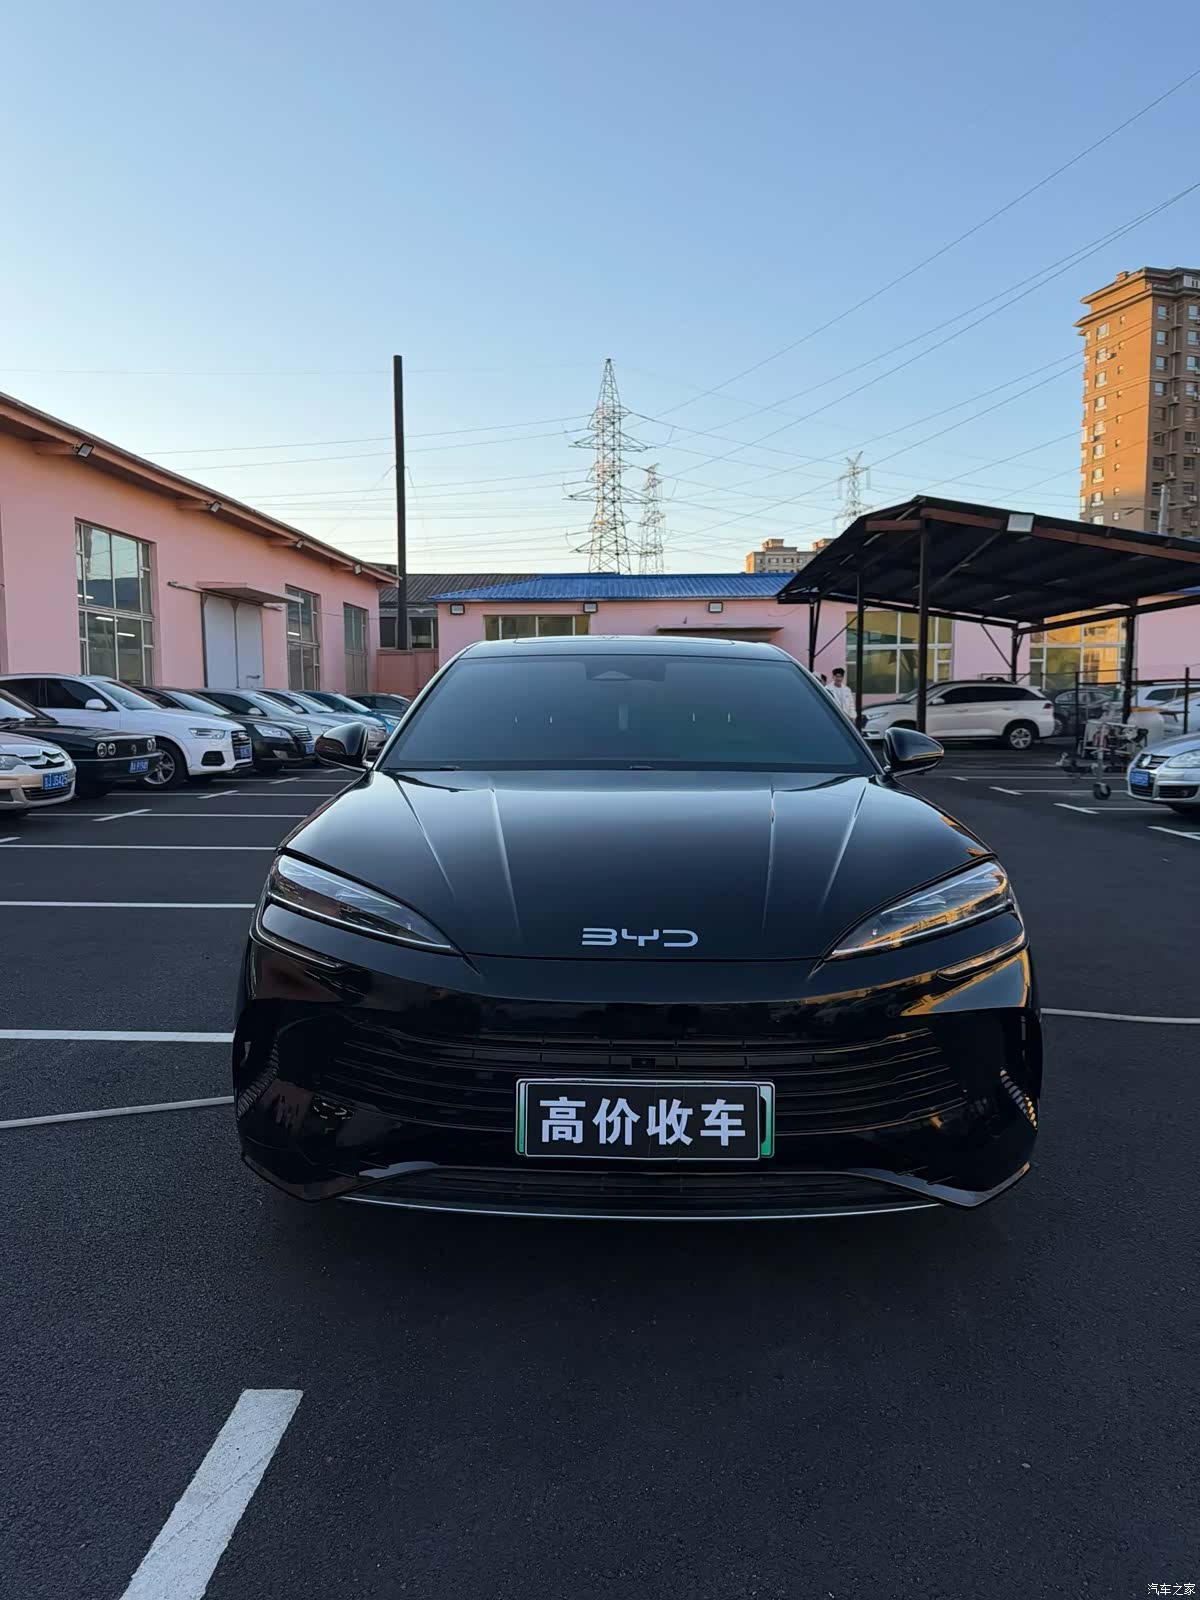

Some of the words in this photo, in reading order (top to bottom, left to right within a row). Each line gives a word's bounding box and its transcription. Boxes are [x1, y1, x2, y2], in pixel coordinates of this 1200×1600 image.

[582, 927, 698, 947] BYD
[539, 1096, 746, 1146] 高价收车
